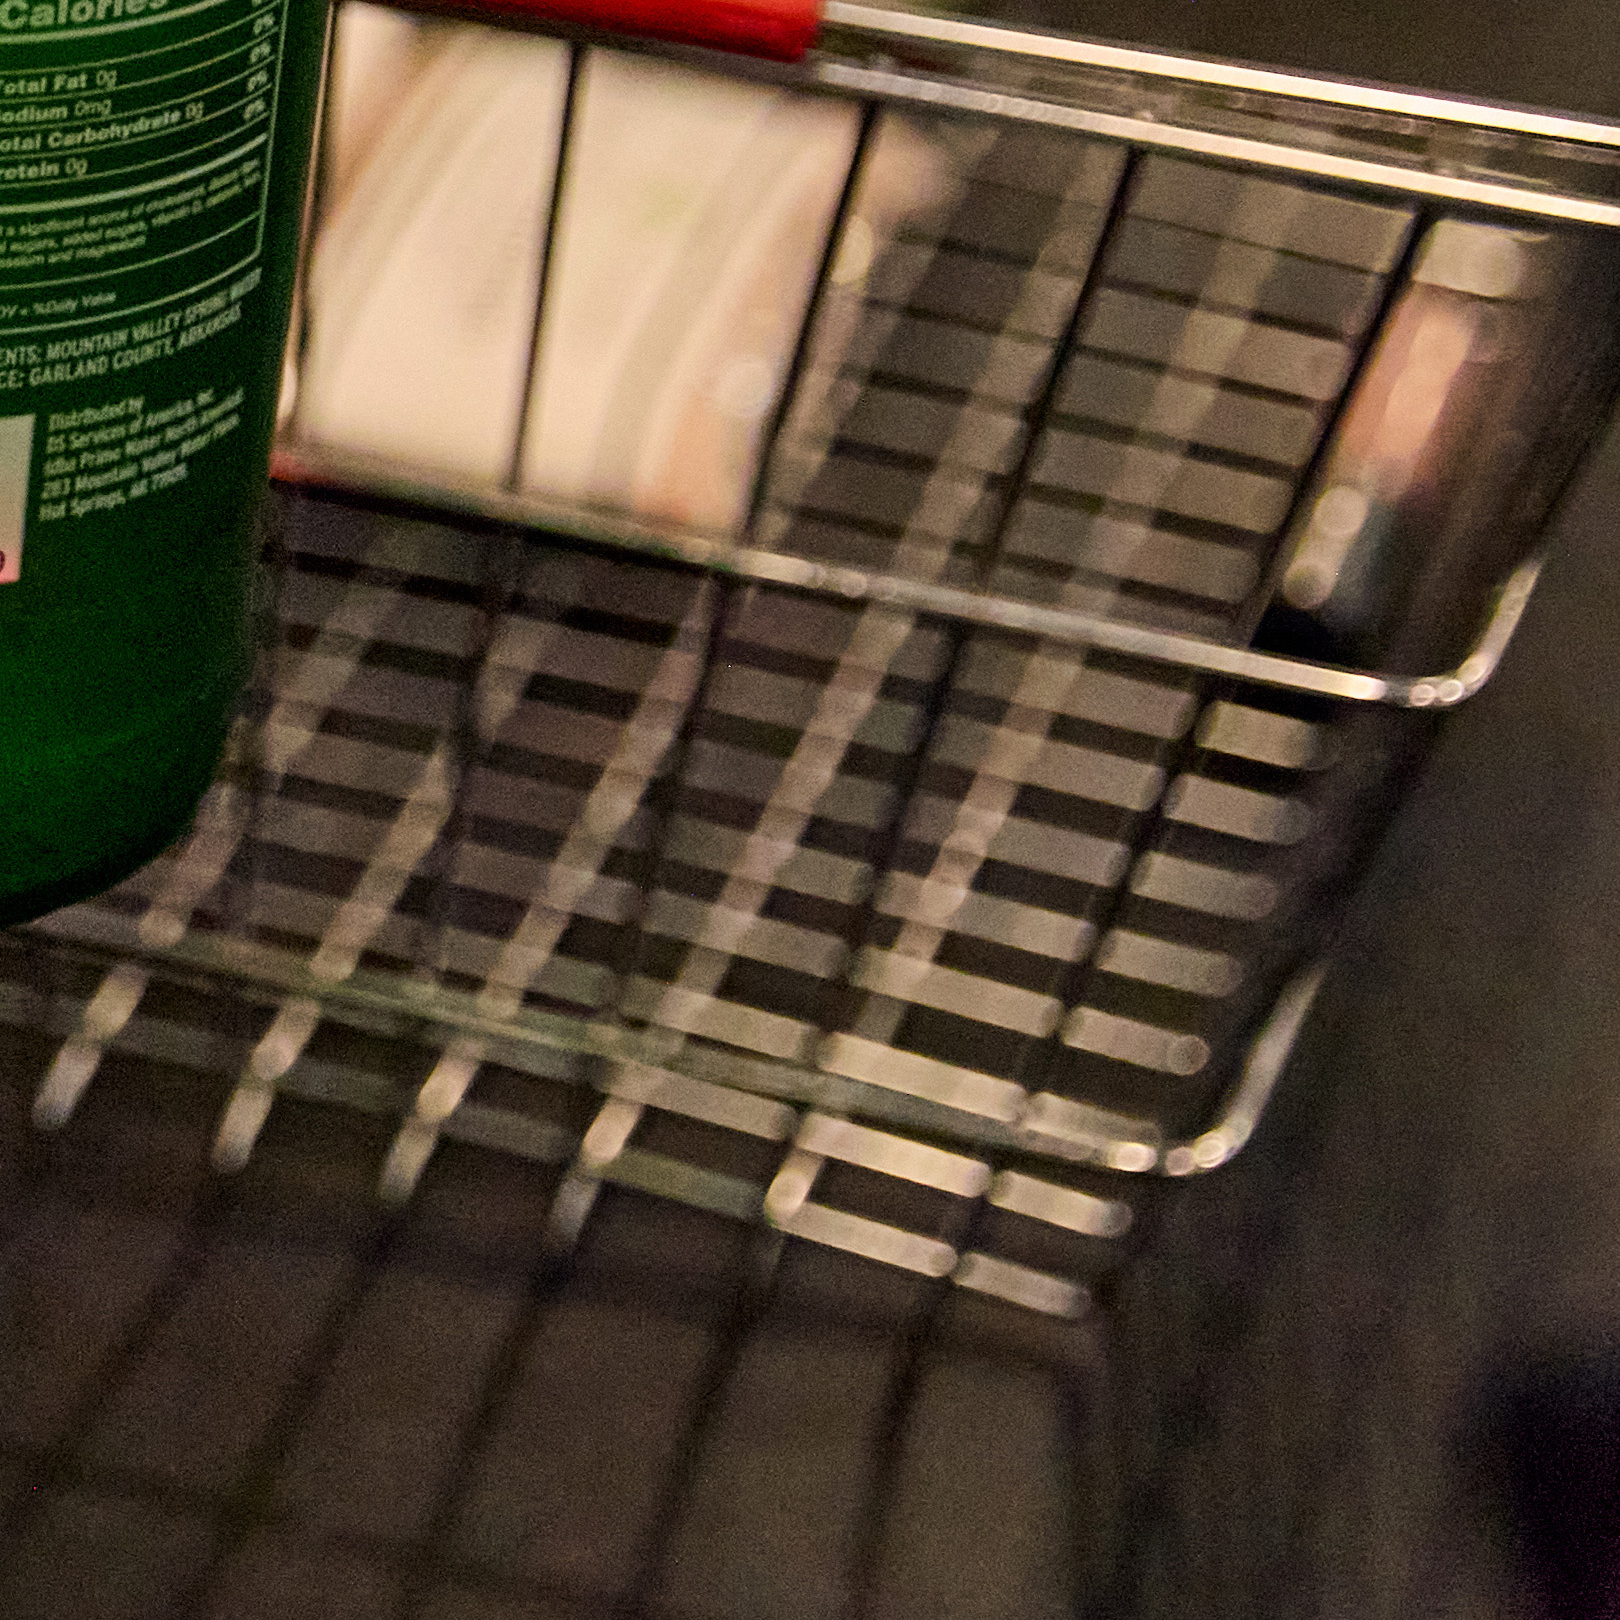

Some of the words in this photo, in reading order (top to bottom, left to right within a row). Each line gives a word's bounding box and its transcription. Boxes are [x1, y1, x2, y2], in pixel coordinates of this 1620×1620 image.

[53, 71, 88, 92] Fat
[47, 109, 182, 149] Carbohydrate
[46, 328, 130, 362] MOUNTAIN
[132, 309, 183, 345] VALLEY
[29, 354, 109, 387] GARLAND
